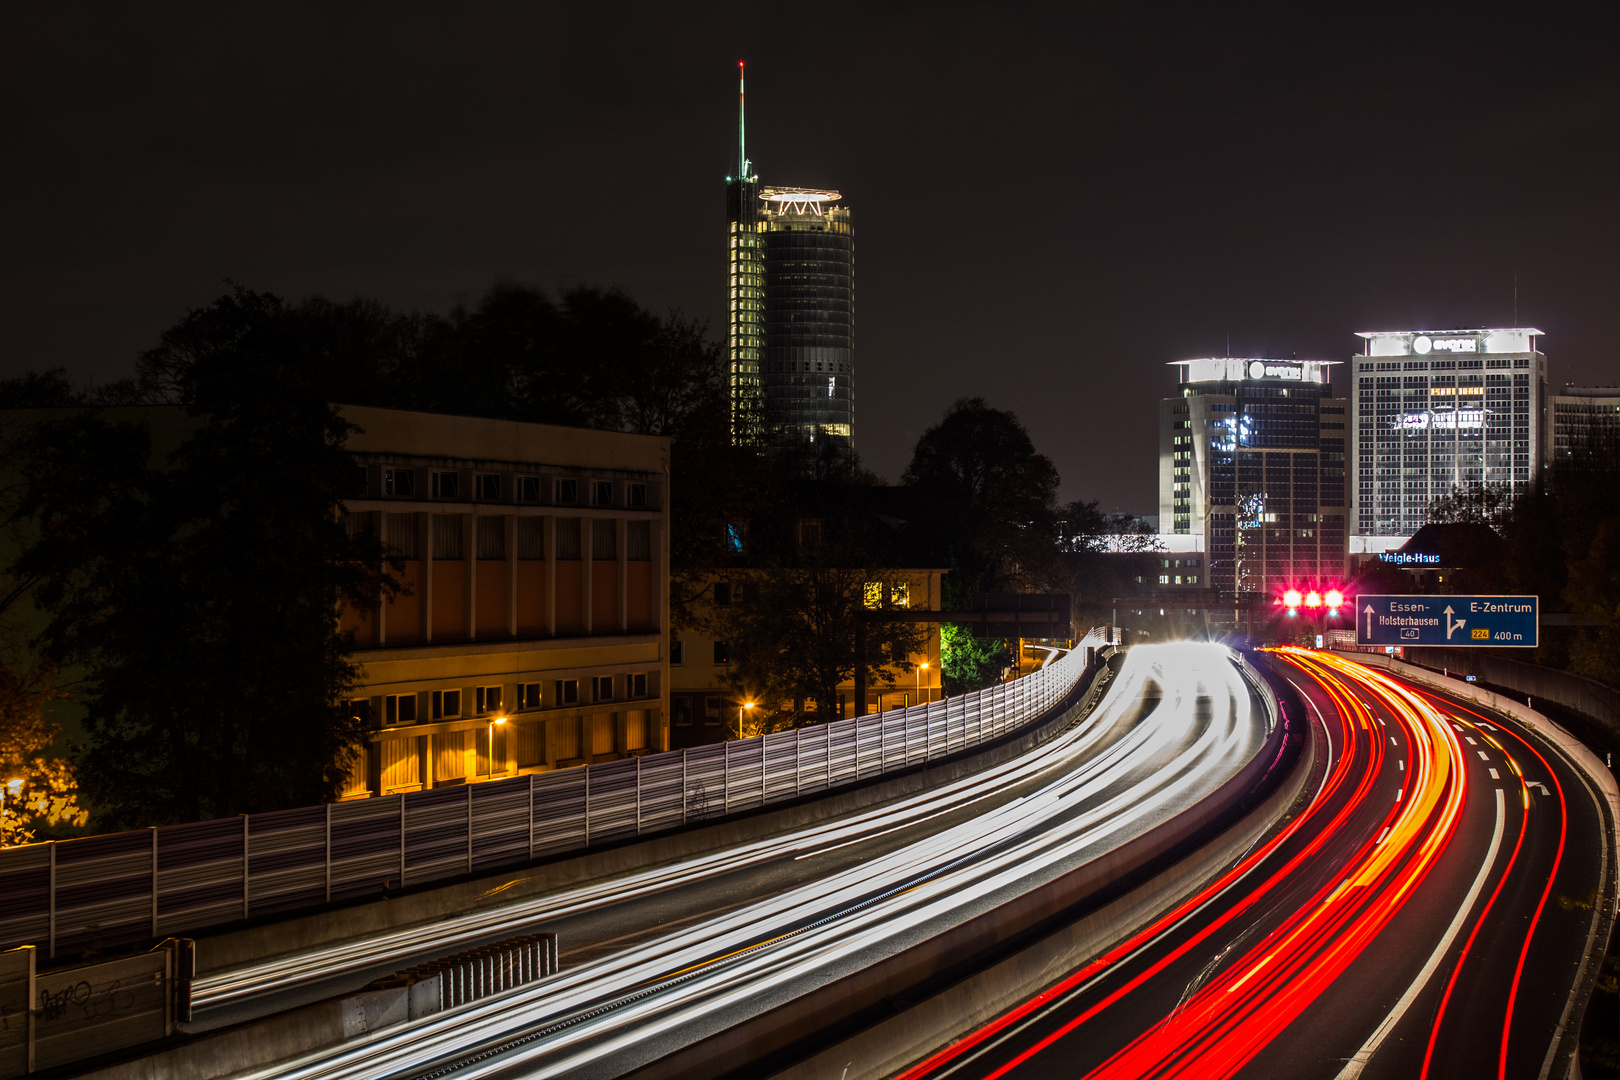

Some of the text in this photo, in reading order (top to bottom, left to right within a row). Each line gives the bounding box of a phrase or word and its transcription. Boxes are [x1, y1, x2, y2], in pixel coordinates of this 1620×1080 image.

[1379, 552, 1440, 564] Weigle-Haus
[1390, 602, 1430, 612] Essen-
[1471, 602, 1532, 612] E-Zentrum
[1379, 615, 1439, 626] Holsterhausen
[1405, 630, 1415, 638] 40
[1473, 630, 1488, 638] 224
[1494, 632, 1512, 640] 400
